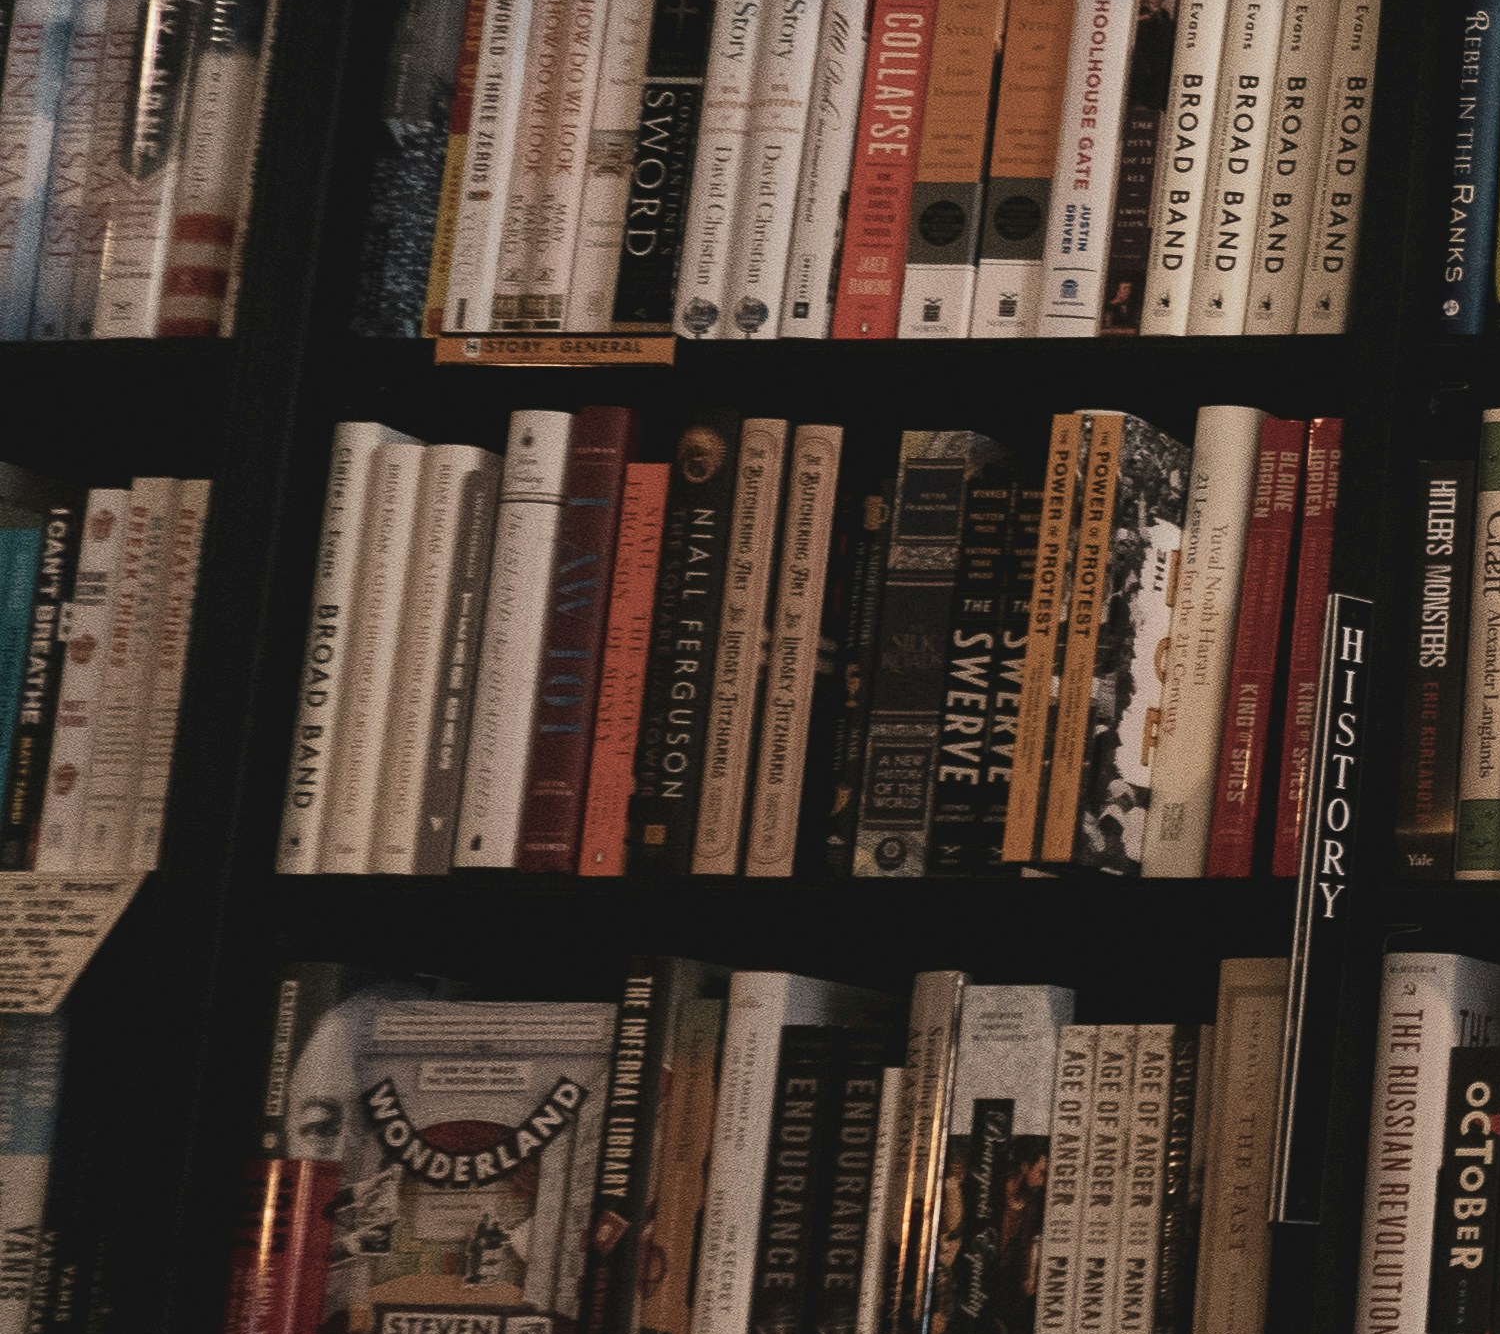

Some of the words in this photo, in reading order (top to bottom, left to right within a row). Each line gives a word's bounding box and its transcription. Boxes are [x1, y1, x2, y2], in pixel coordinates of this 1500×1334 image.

[866, 11, 925, 158] COLLAPSE
[1173, 73, 1204, 174] BROAD
[626, 87, 676, 259] SWORD
[1072, 135, 1097, 191] GATE
[1161, 189, 1191, 272] BAND
[1317, 627, 1366, 919] HISTORY
[362, 1077, 589, 1189] WONDERLAND
[1449, 1080, 1494, 1269] OCTOBER
